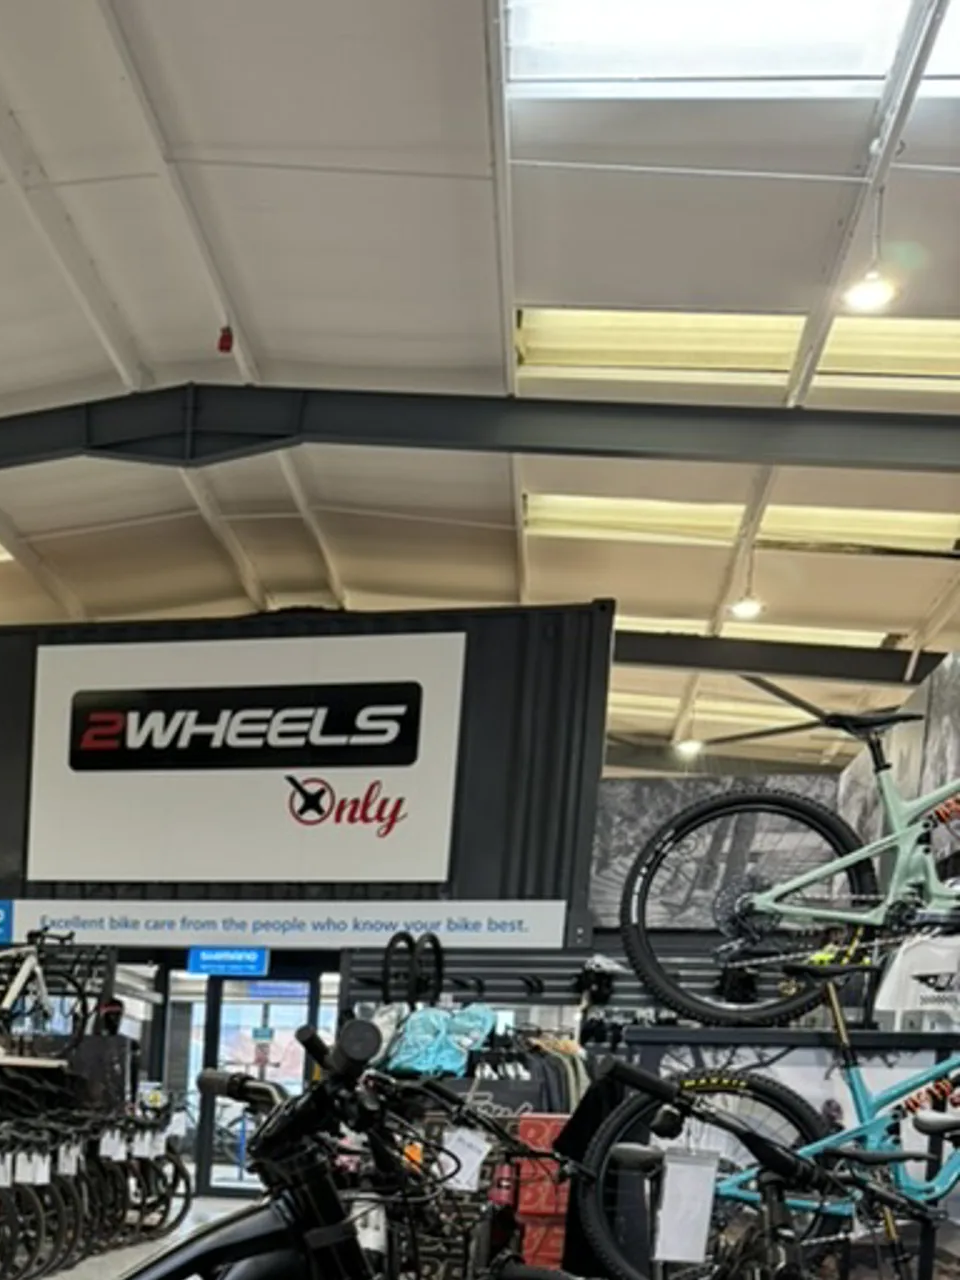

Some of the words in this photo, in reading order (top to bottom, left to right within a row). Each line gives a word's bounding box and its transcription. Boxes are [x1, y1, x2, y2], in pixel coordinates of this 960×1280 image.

[80, 704, 408, 750] 2WHEELS
[287, 775, 408, 838] Only
[39, 914, 105, 932] Excellent
[109, 915, 139, 932] bike
[144, 919, 174, 932] care
[179, 916, 218, 932] from
[222, 916, 246, 932] the
[251, 916, 307, 938] people
[311, 917, 348, 933] who
[352, 917, 399, 933] know
[402, 920, 441, 937] your
[446, 917, 481, 934] bike
[487, 917, 529, 934] best.
